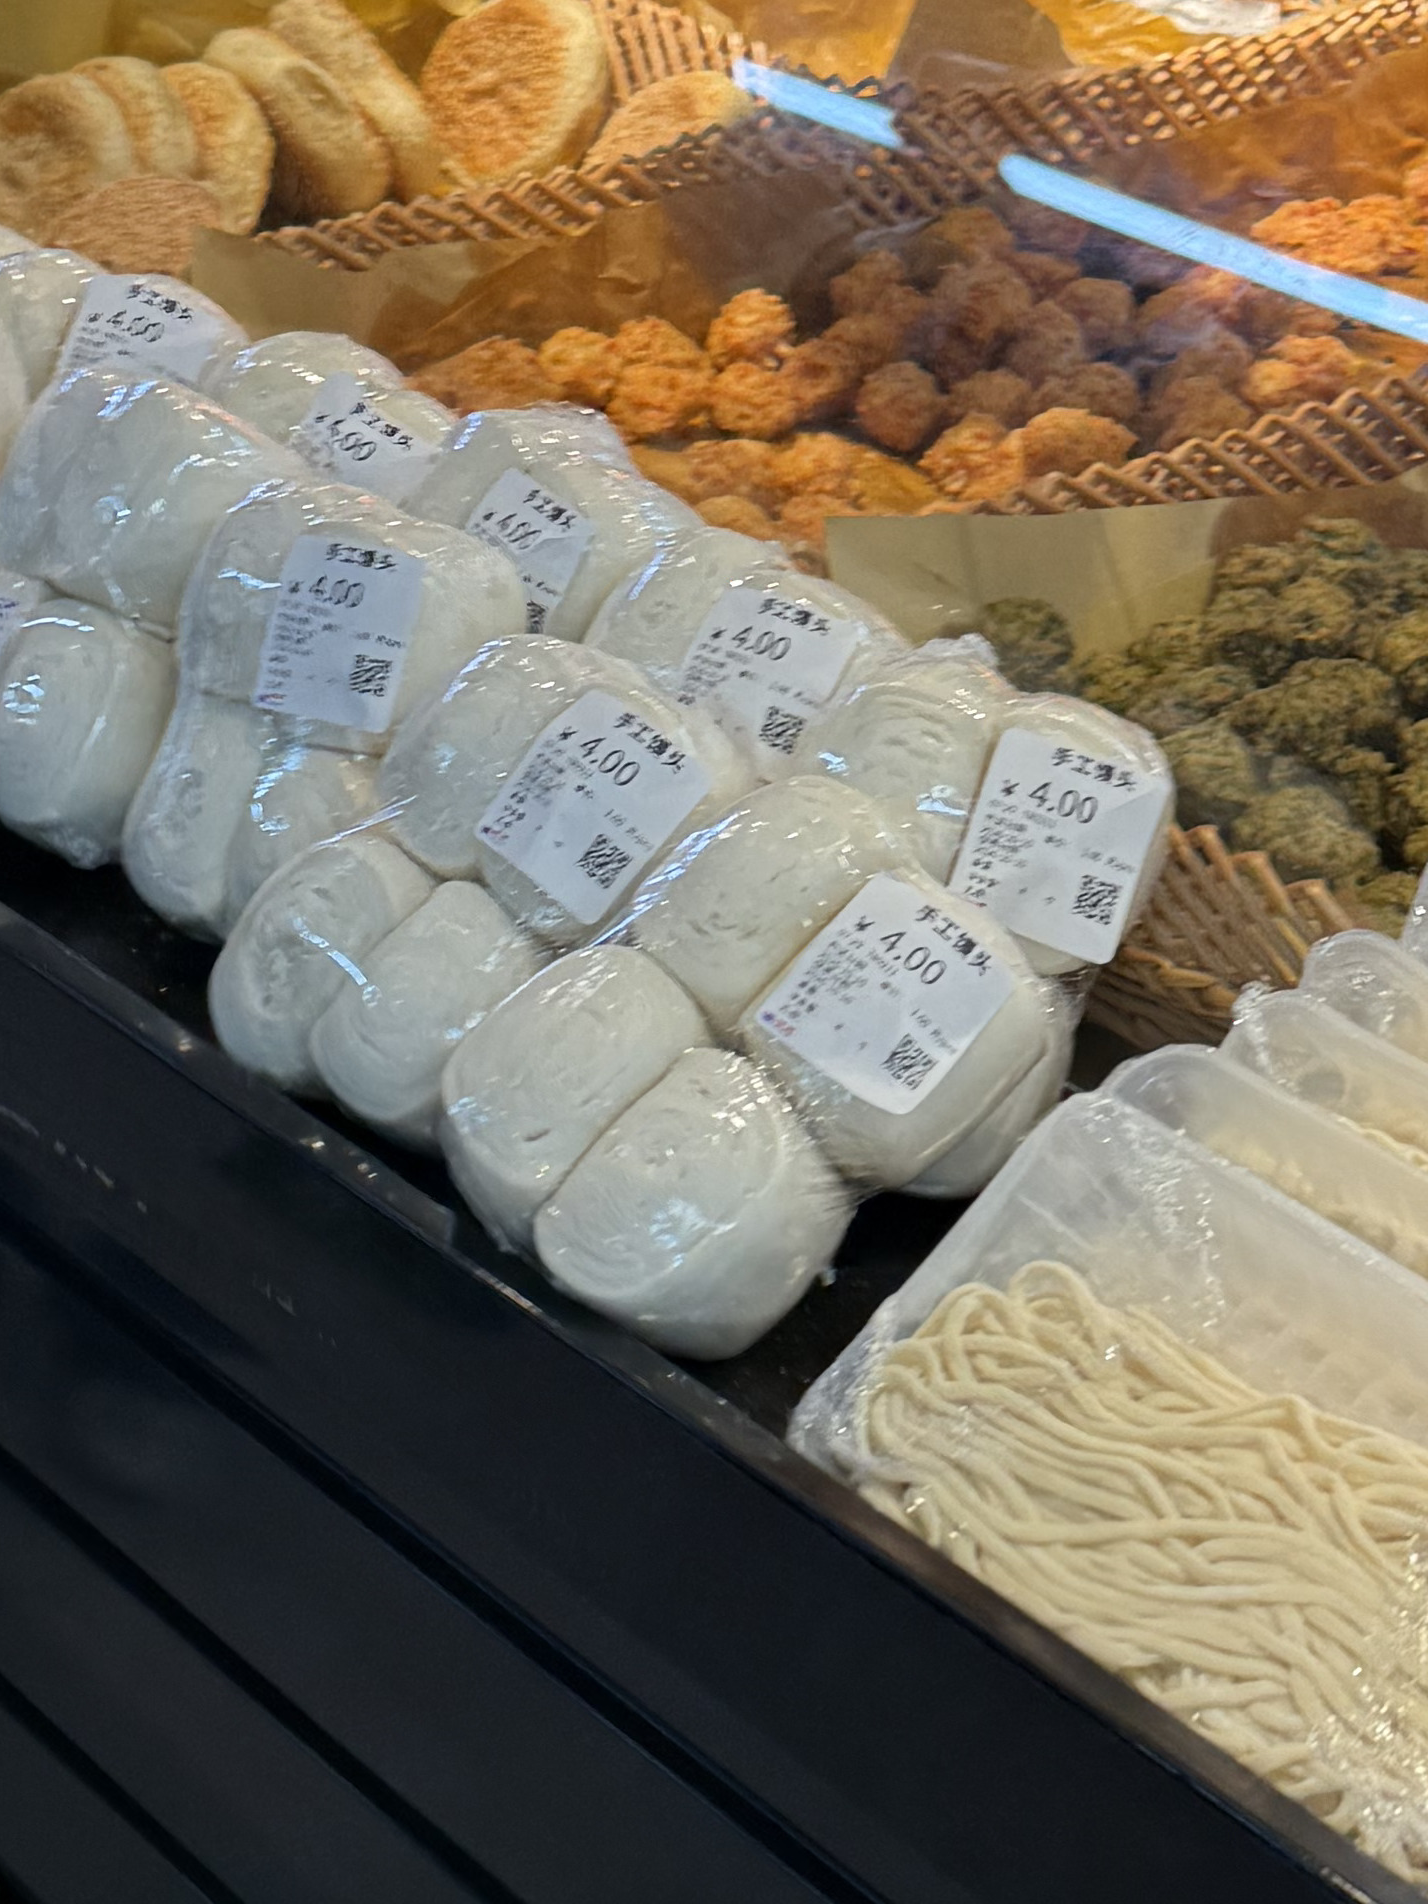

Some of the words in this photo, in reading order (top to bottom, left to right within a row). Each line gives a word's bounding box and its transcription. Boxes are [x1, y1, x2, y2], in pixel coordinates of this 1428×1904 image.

[309, 576, 363, 607] 4.00
[732, 626, 790, 660] 4.00
[580, 738, 640, 786] 4.00
[1028, 782, 1097, 823] 4.00
[880, 932, 946, 984] 4.00
[915, 906, 991, 976] 手工馒头
